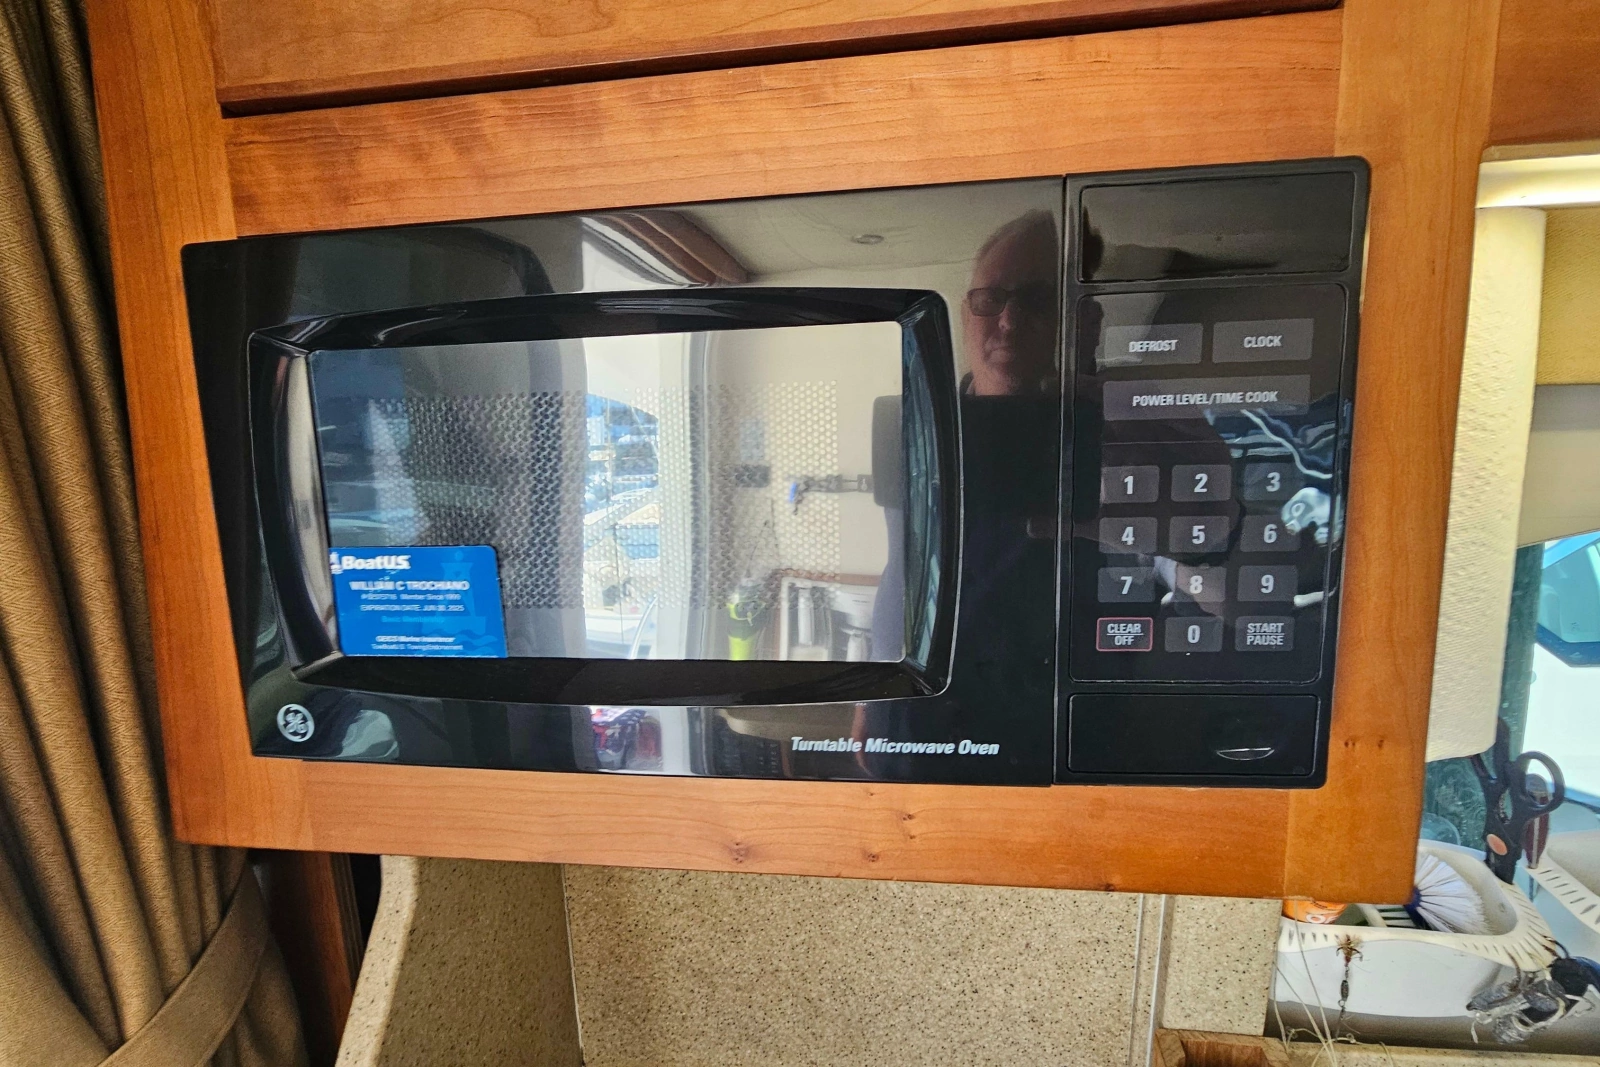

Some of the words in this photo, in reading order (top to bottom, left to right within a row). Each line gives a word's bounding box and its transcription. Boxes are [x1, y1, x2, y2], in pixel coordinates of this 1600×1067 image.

[1129, 339, 1178, 353] DEFROST
[1243, 335, 1283, 348] CLOCK
[1132, 395, 1174, 407] POWER
[1175, 391, 1244, 406] LEVEL/TIME
[1245, 391, 1279, 403] COOK
[1123, 475, 1134, 495] 1
[1193, 473, 1208, 493] 2
[1266, 472, 1280, 492] 3
[1121, 526, 1135, 546] 4
[1191, 525, 1206, 545] 5
[1263, 524, 1277, 544] 6
[341, 554, 411, 570] BoatUS
[395, 581, 406, 591] C
[1120, 576, 1133, 595] 7
[1189, 575, 1203, 594] 8
[1260, 574, 1274, 594] 9
[1107, 623, 1142, 634] CLEAR
[1187, 625, 1200, 644] 0
[1247, 622, 1285, 633] START
[1114, 635, 1135, 646] OFF
[1246, 635, 1284, 646] PAUSE
[791, 736, 862, 753] Turntable
[864, 738, 956, 754] Microwave
[957, 739, 1000, 755] Oven
